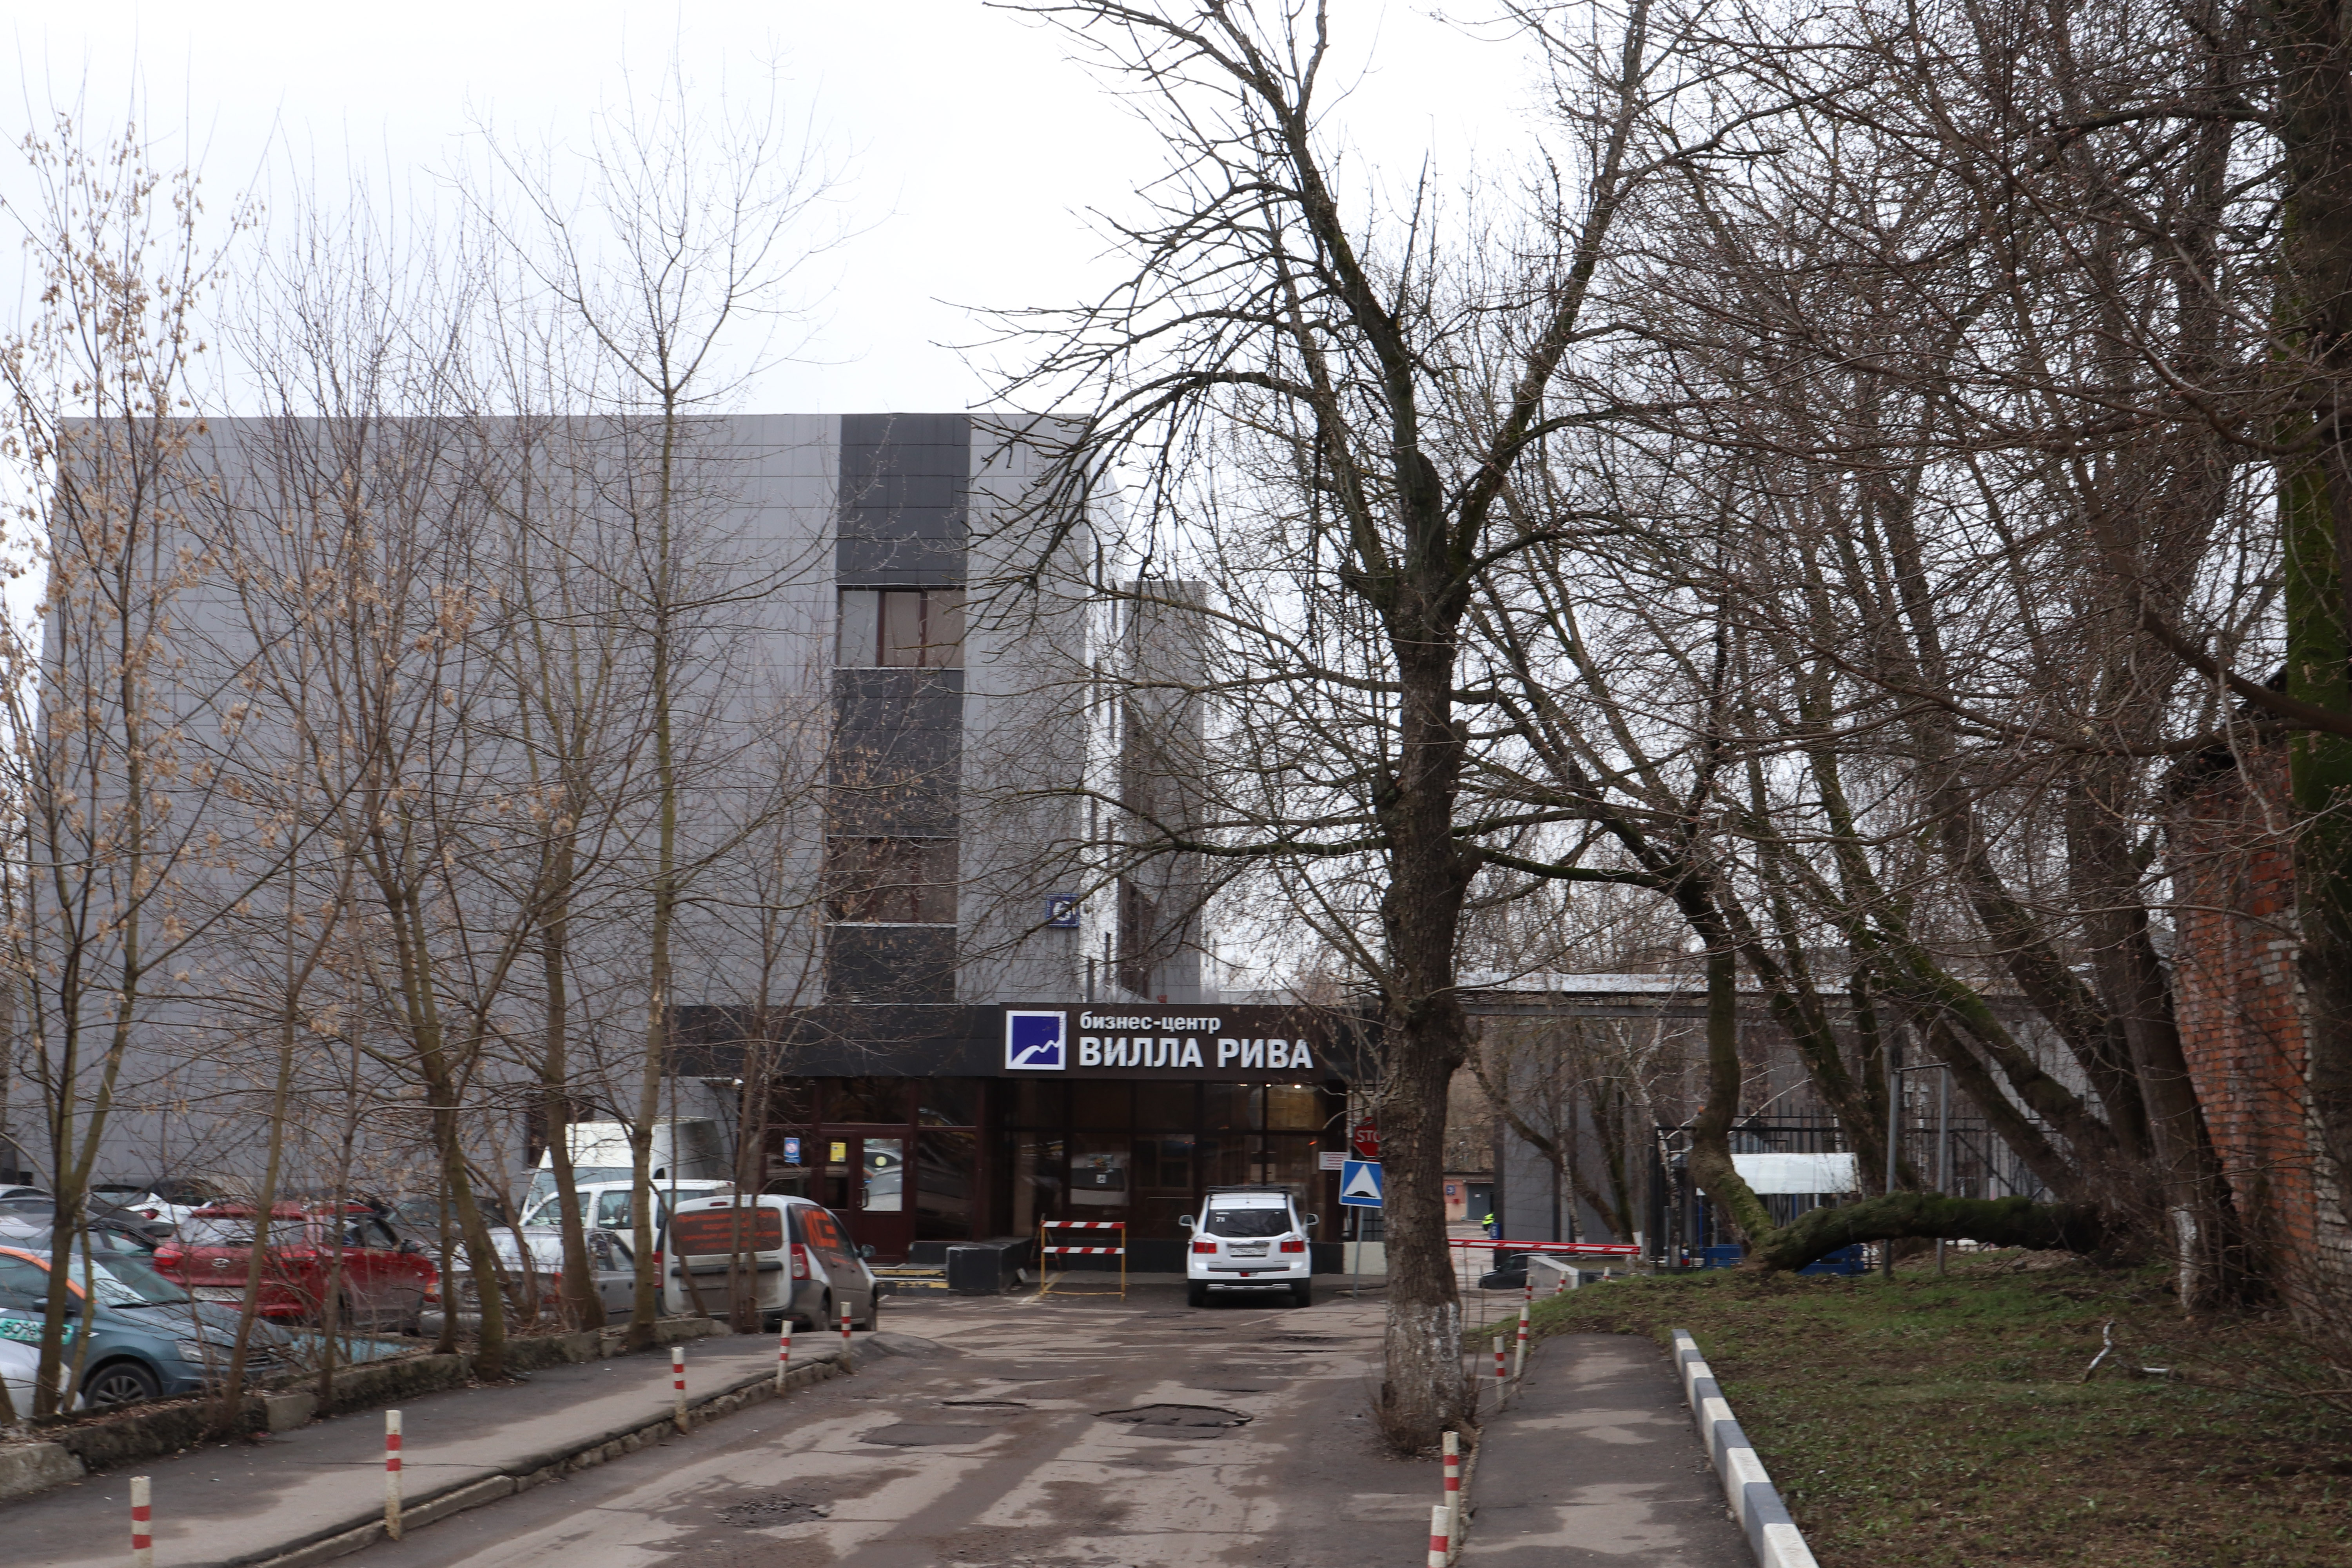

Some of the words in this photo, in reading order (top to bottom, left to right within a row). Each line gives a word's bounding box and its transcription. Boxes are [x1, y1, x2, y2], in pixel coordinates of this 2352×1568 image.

[1079, 1011, 1221, 1034] бизнес-центр
[1079, 1036, 1204, 1068] ВИЛЛА
[1217, 1038, 1314, 1069] РИВА
[1356, 1130, 1380, 1143] STO
